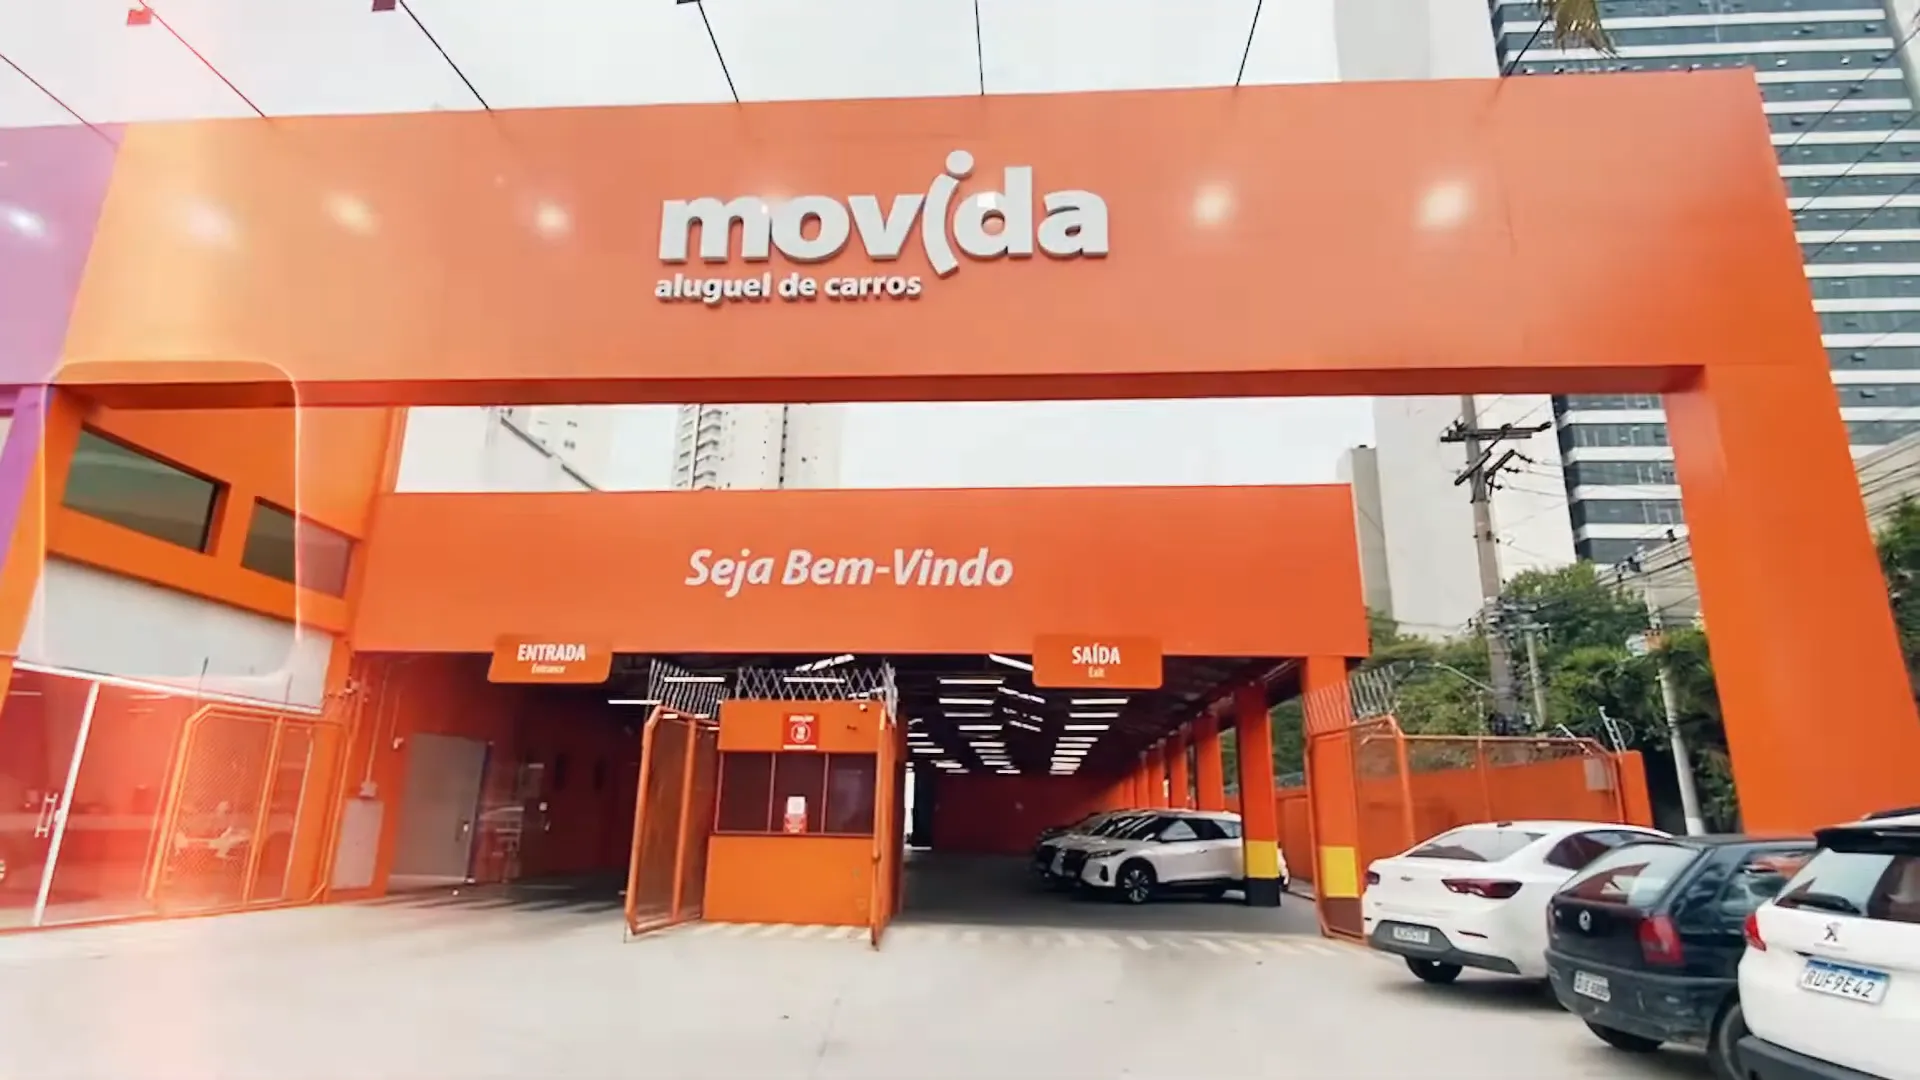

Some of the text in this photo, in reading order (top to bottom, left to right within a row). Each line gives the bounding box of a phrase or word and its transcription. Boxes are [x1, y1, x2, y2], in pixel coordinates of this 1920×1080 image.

[659, 150, 1109, 276] movida
[655, 272, 922, 306] aluguel de carros
[685, 546, 1014, 598] Seja Bem-Vindo
[517, 643, 586, 662] ENTRADA
[1071, 642, 1121, 665] SAÍDA
[1804, 969, 1875, 998] RUF9E42
